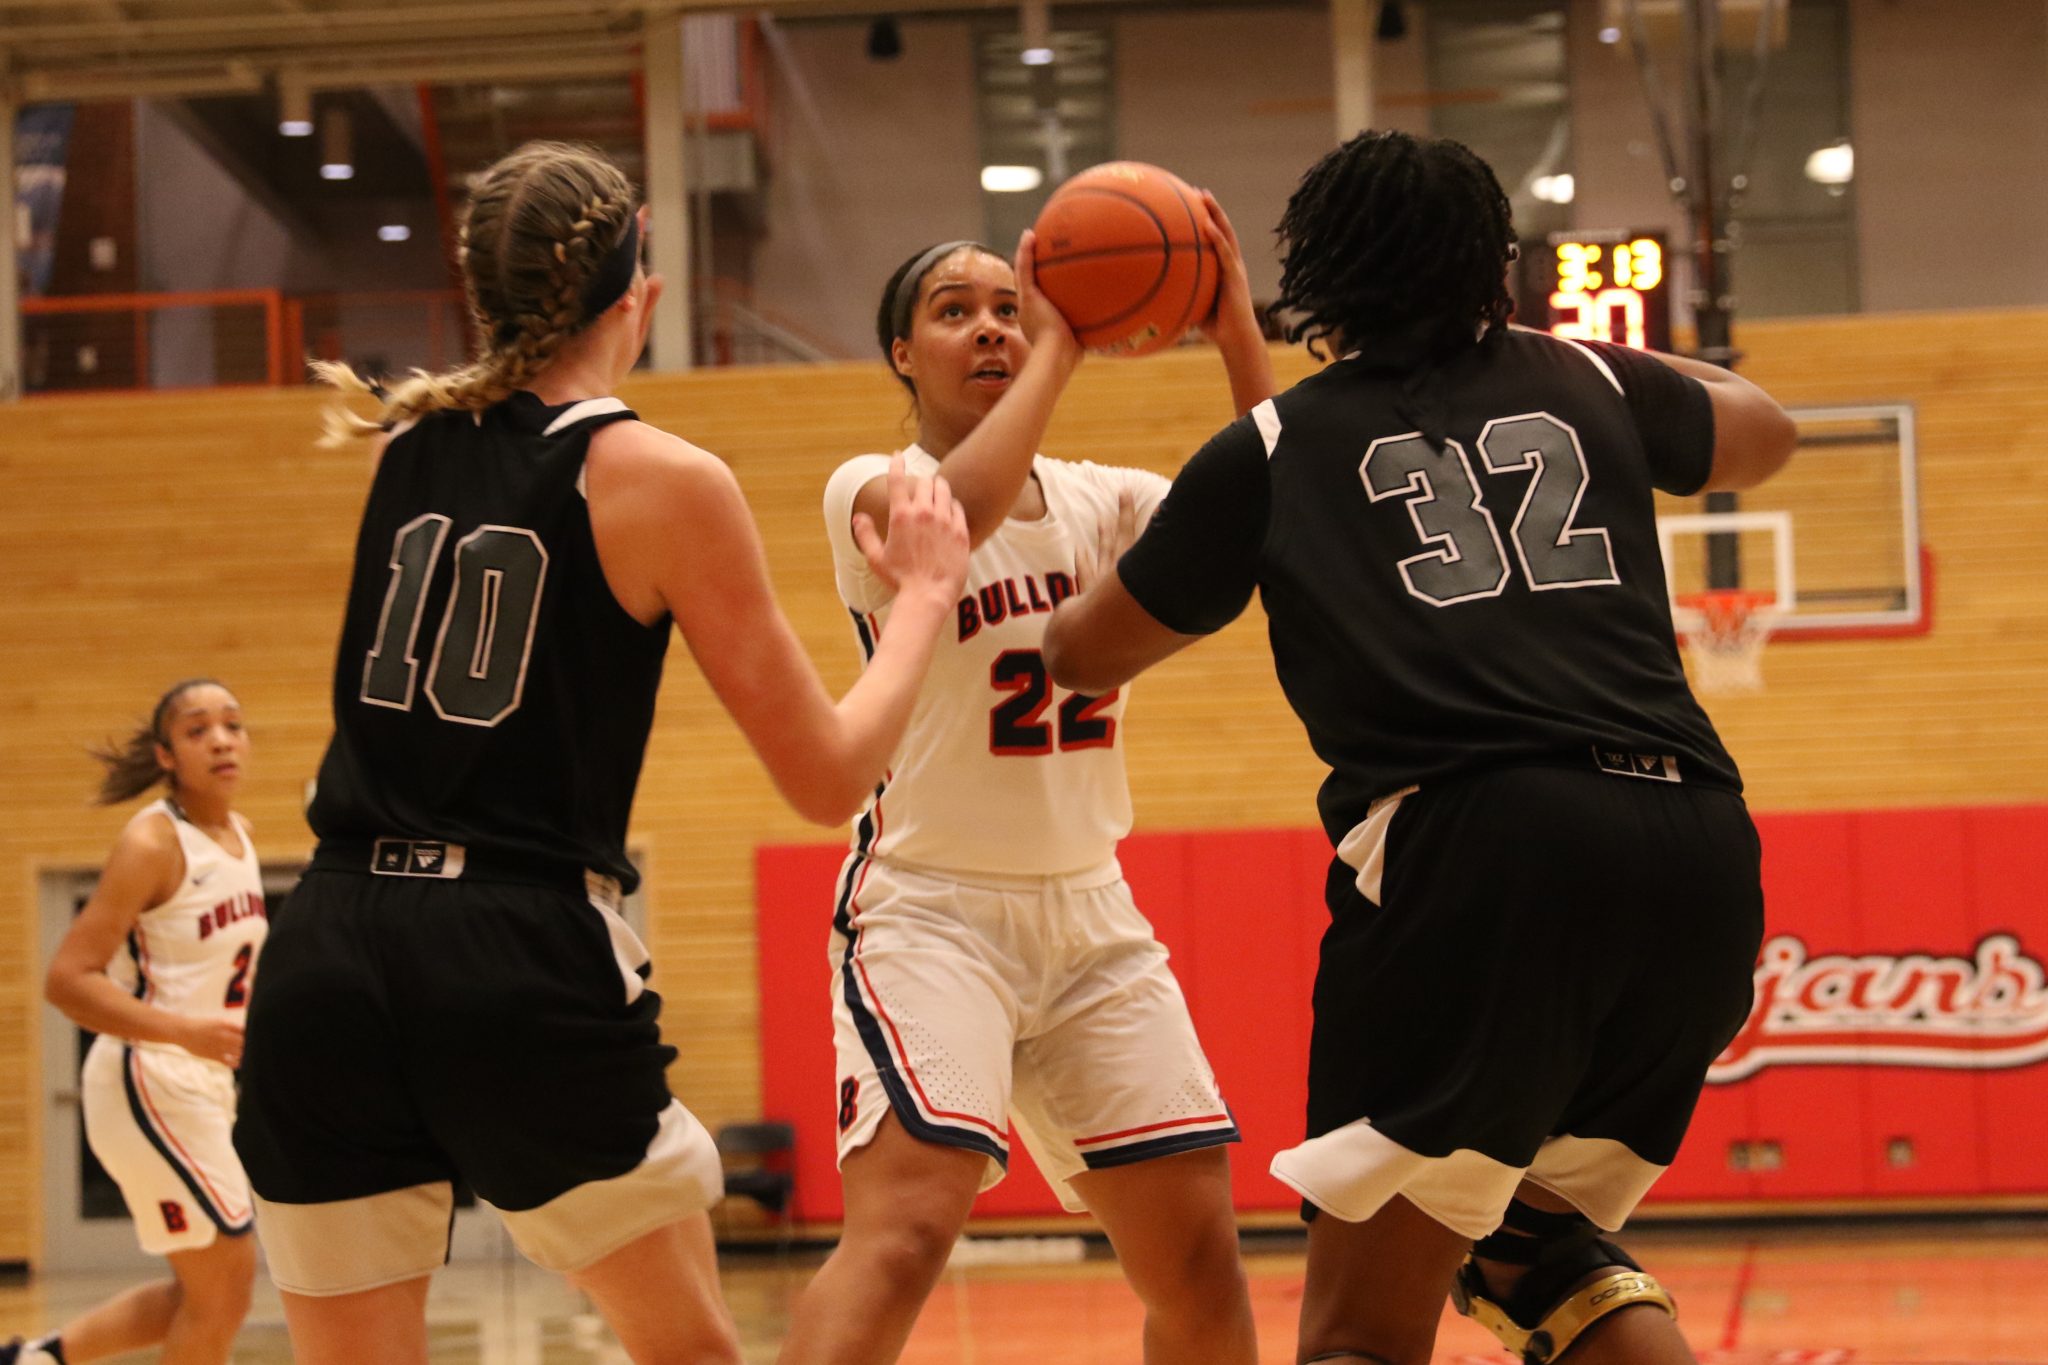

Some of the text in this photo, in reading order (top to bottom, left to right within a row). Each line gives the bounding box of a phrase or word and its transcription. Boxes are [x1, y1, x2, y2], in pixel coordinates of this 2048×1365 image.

[1556, 239, 1662, 291] 3:13
[1358, 411, 1621, 607] 32
[360, 512, 549, 728] 10
[957, 571, 1081, 643] BULLD
[989, 648, 1119, 756] 22
[839, 1075, 859, 1135] B
[160, 1200, 188, 1233] B
